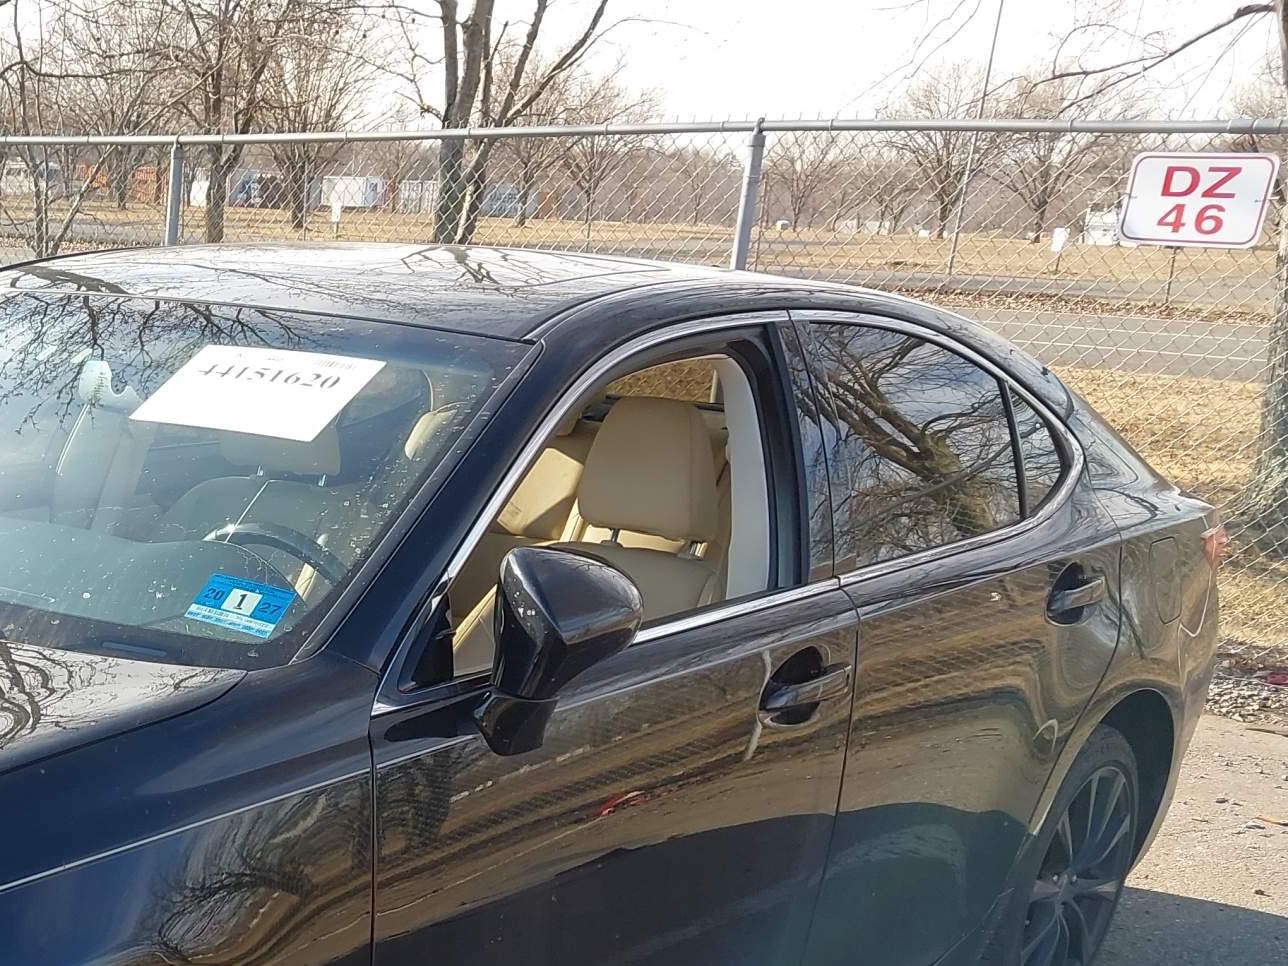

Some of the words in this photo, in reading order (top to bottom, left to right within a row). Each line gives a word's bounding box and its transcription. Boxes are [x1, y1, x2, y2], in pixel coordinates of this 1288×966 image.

[1160, 166, 1242, 198] DZ
[1156, 203, 1226, 235] 46
[198, 363, 341, 389] 44151620
[204, 587, 225, 601] 20
[233, 593, 248, 610] 1
[258, 602, 281, 615] 27
